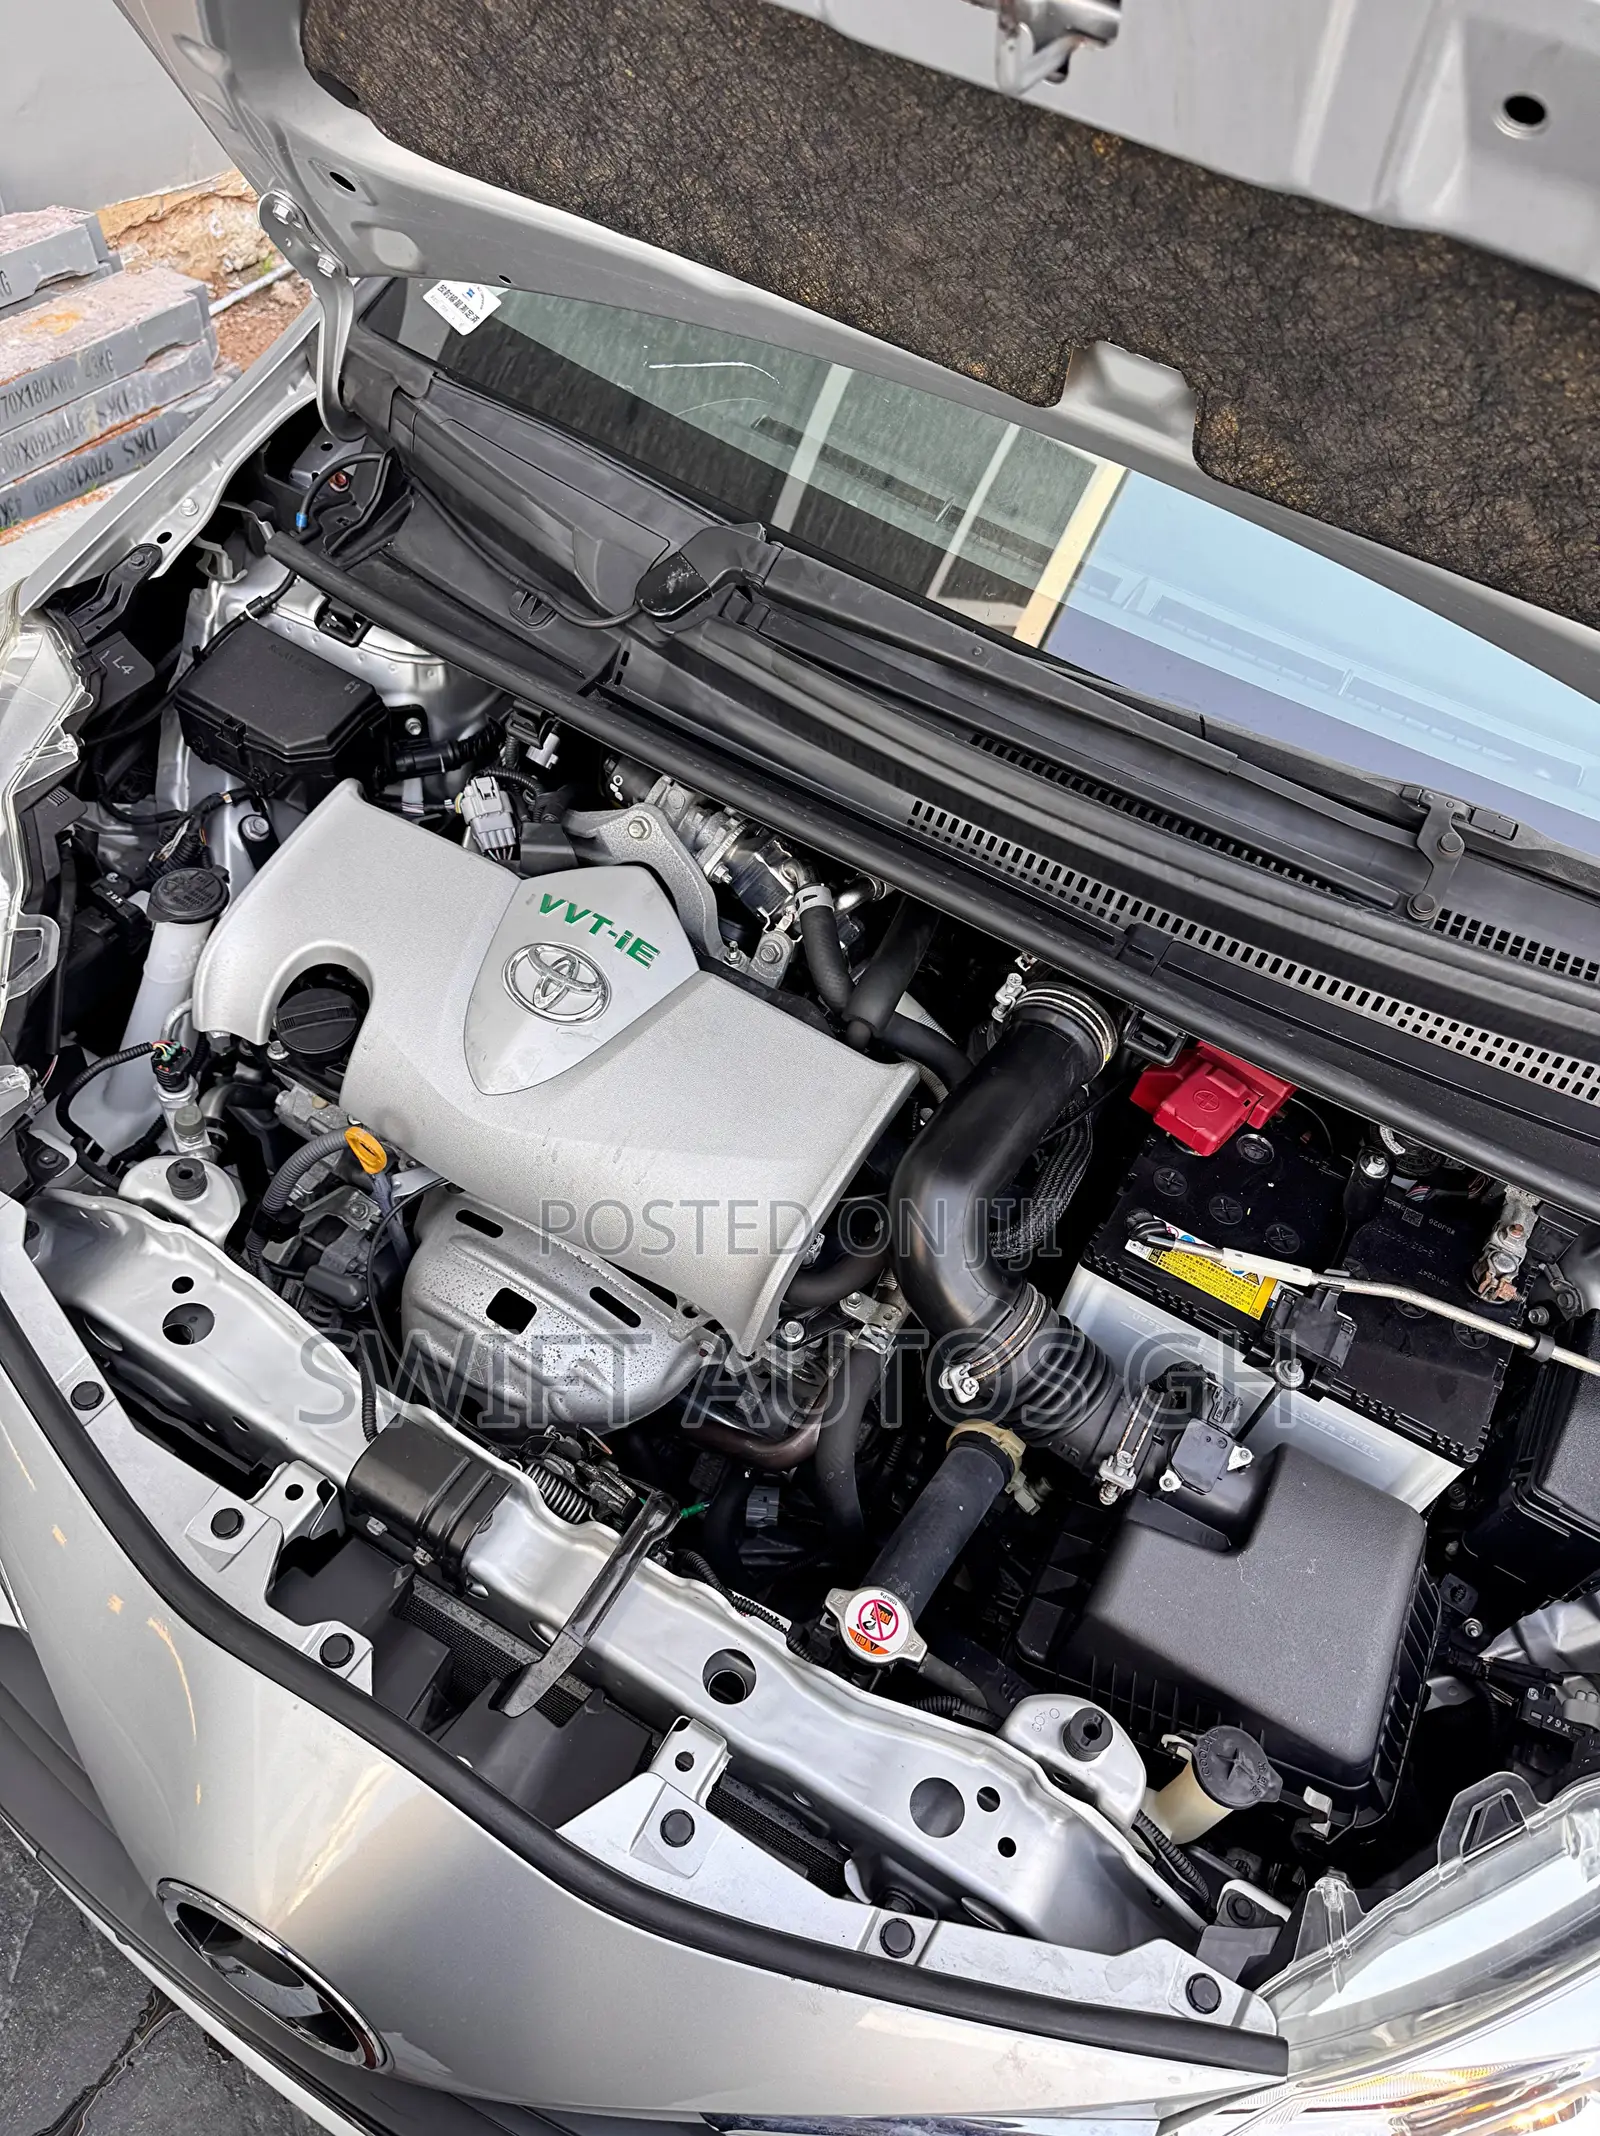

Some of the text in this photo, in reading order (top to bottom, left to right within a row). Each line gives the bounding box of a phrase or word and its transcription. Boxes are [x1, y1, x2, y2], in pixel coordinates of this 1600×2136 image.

[122, 427, 158, 463] DKS
[539, 893, 661, 970] VVT-iE
[1294, 1409, 1377, 1456] LOWER LEVEL
[1546, 1715, 1570, 1733] 79X
